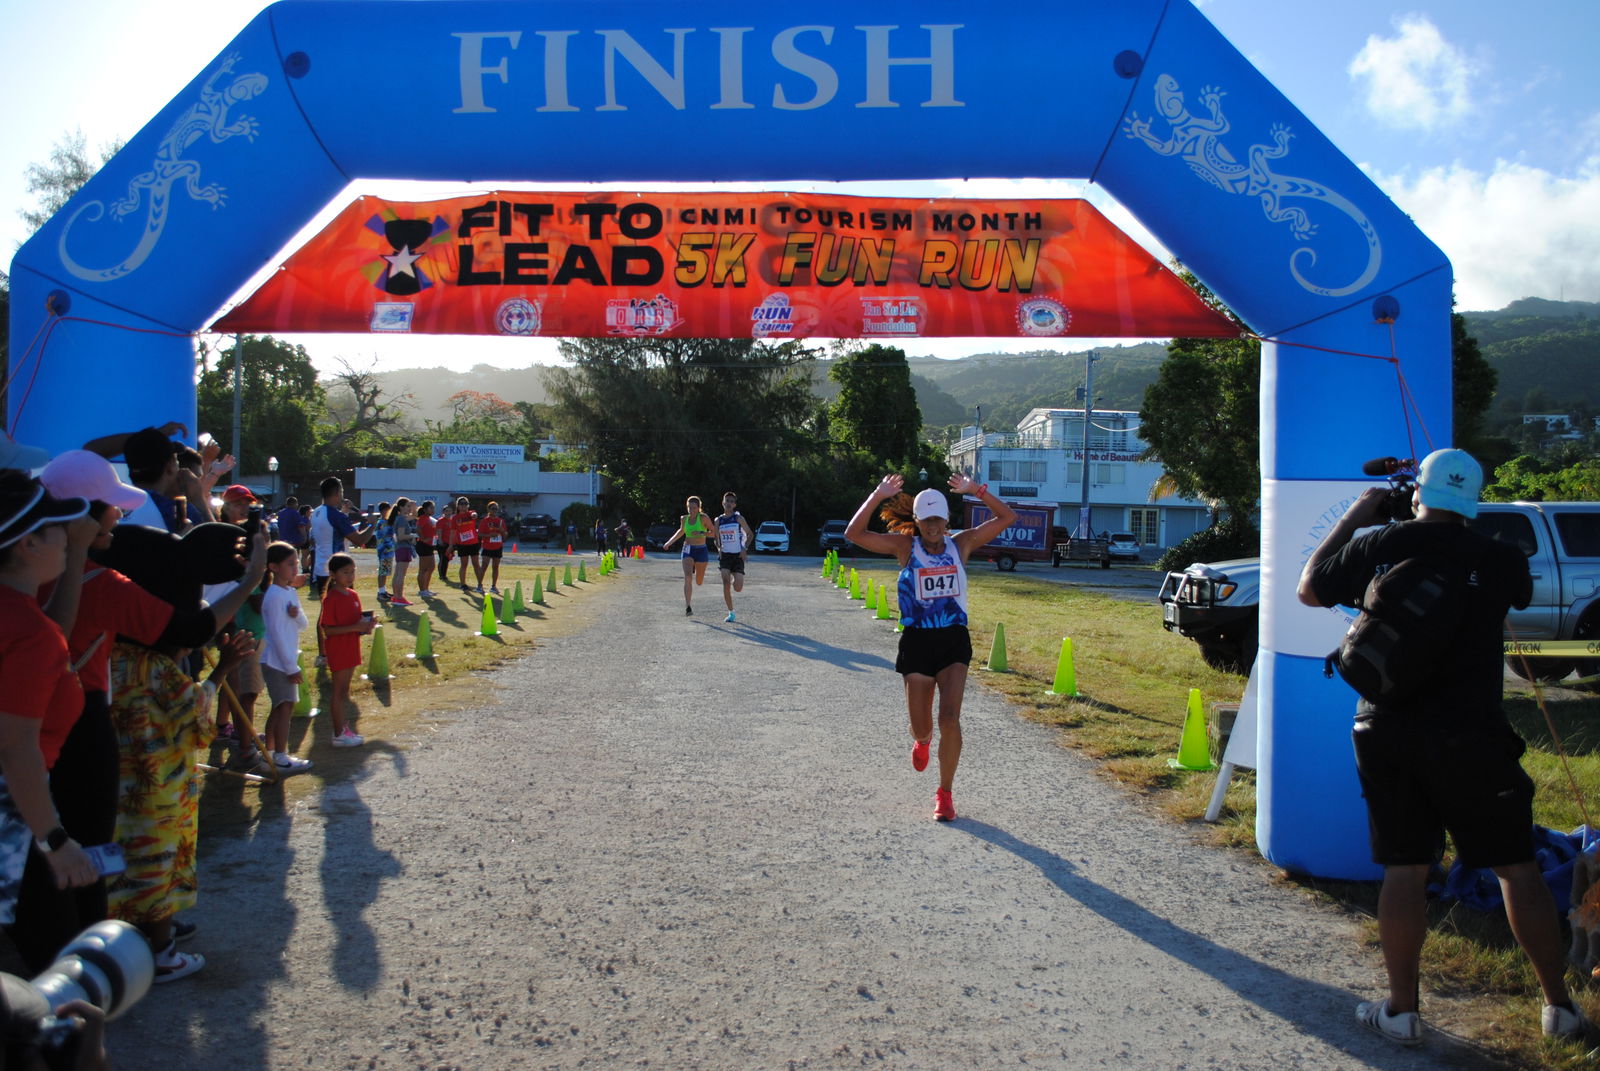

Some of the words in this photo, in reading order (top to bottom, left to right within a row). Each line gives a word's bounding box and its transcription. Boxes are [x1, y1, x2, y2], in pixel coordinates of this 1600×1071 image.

[451, 23, 965, 114] FINISH
[458, 201, 554, 238] FIT
[574, 203, 663, 240] TO
[680, 207, 757, 226] CNMI
[777, 206, 912, 232] TOURISM
[933, 211, 1043, 232] MONTH
[457, 243, 664, 286] LEAD
[674, 232, 757, 288] 5K
[776, 231, 896, 288] FUN
[918, 238, 1042, 293] RUN
[751, 306, 793, 320] RUN
[862, 302, 881, 316] Tan
[863, 318, 917, 333] Foundation
[449, 445, 469, 454] RNV
[924, 574, 954, 592] 047
[1504, 642, 1541, 654] AUTION
